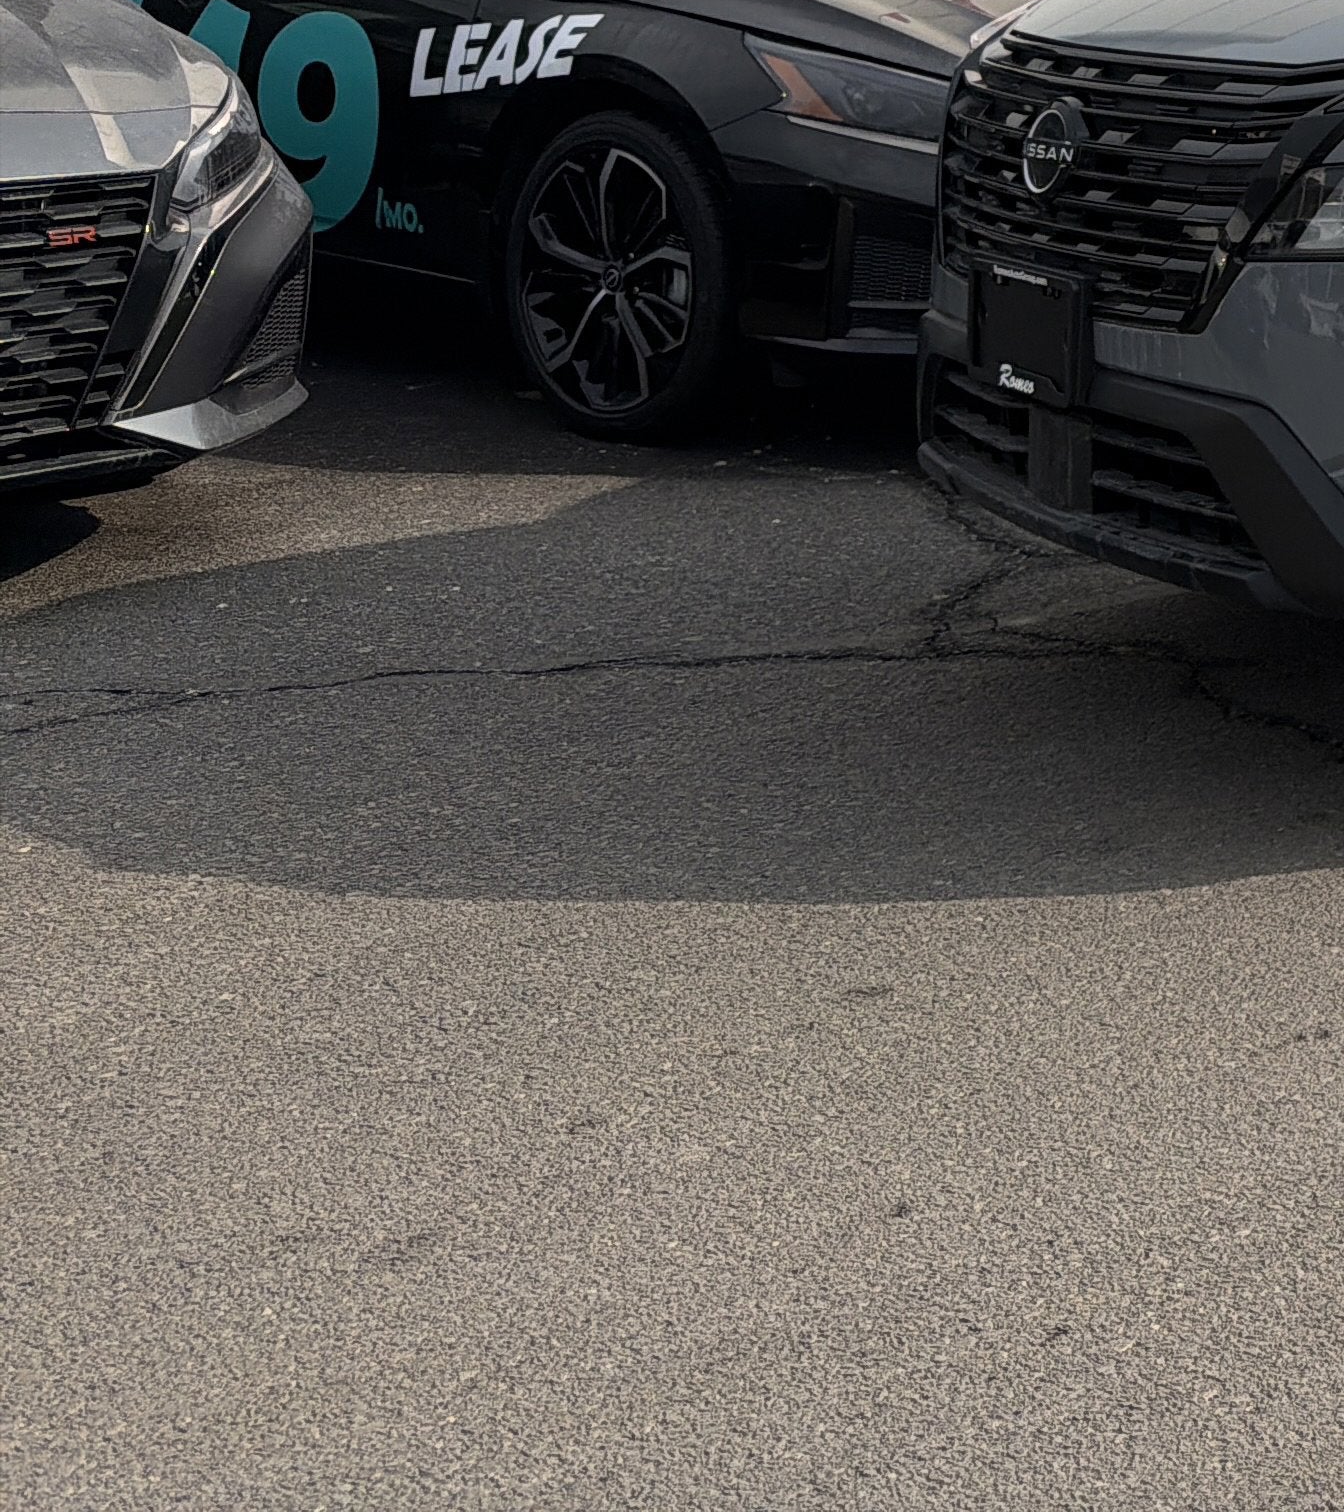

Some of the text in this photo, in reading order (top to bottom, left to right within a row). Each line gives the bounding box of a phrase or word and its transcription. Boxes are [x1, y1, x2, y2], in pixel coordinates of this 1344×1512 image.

[409, 13, 605, 98] LEASE
[46, 226, 98, 247] SR
[998, 363, 1035, 395] Romeo
